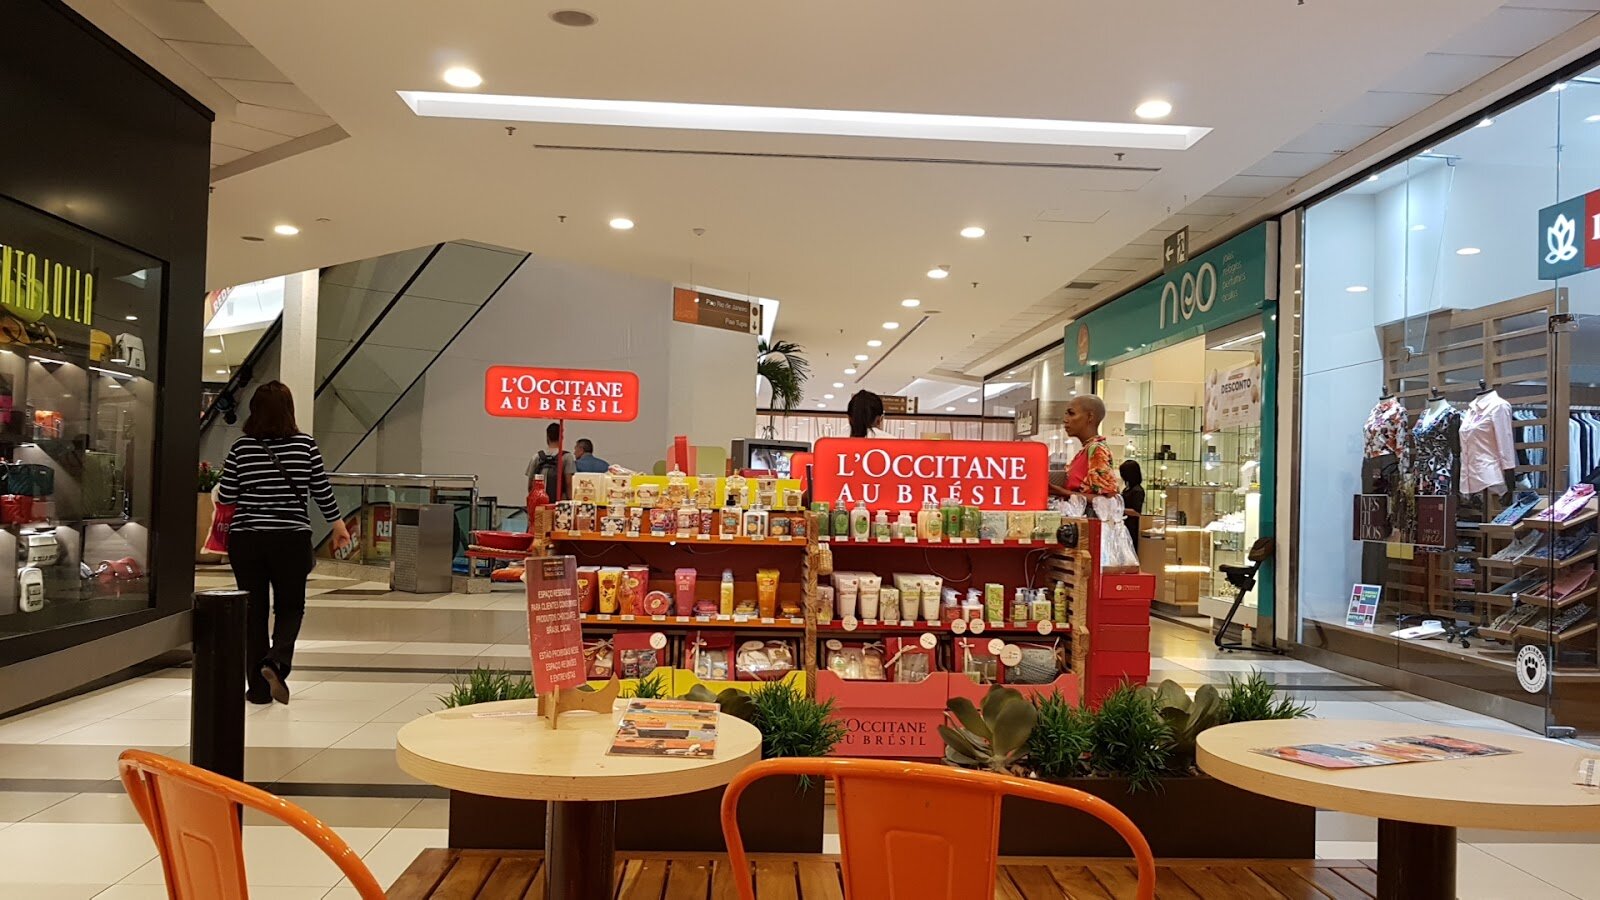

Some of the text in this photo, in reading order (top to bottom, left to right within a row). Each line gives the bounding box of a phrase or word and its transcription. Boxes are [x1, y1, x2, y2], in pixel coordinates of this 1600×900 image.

[43, 258, 93, 325] LOLLA
[501, 374, 623, 398] L'OCCITANE
[1220, 378, 1252, 394] DESCONTO
[500, 396, 623, 414] AU BRÉSIL
[836, 449, 1028, 480] L'OCCITANE
[837, 480, 1026, 506] AU BRÉSIL
[863, 733, 927, 746] BRÉSIL
